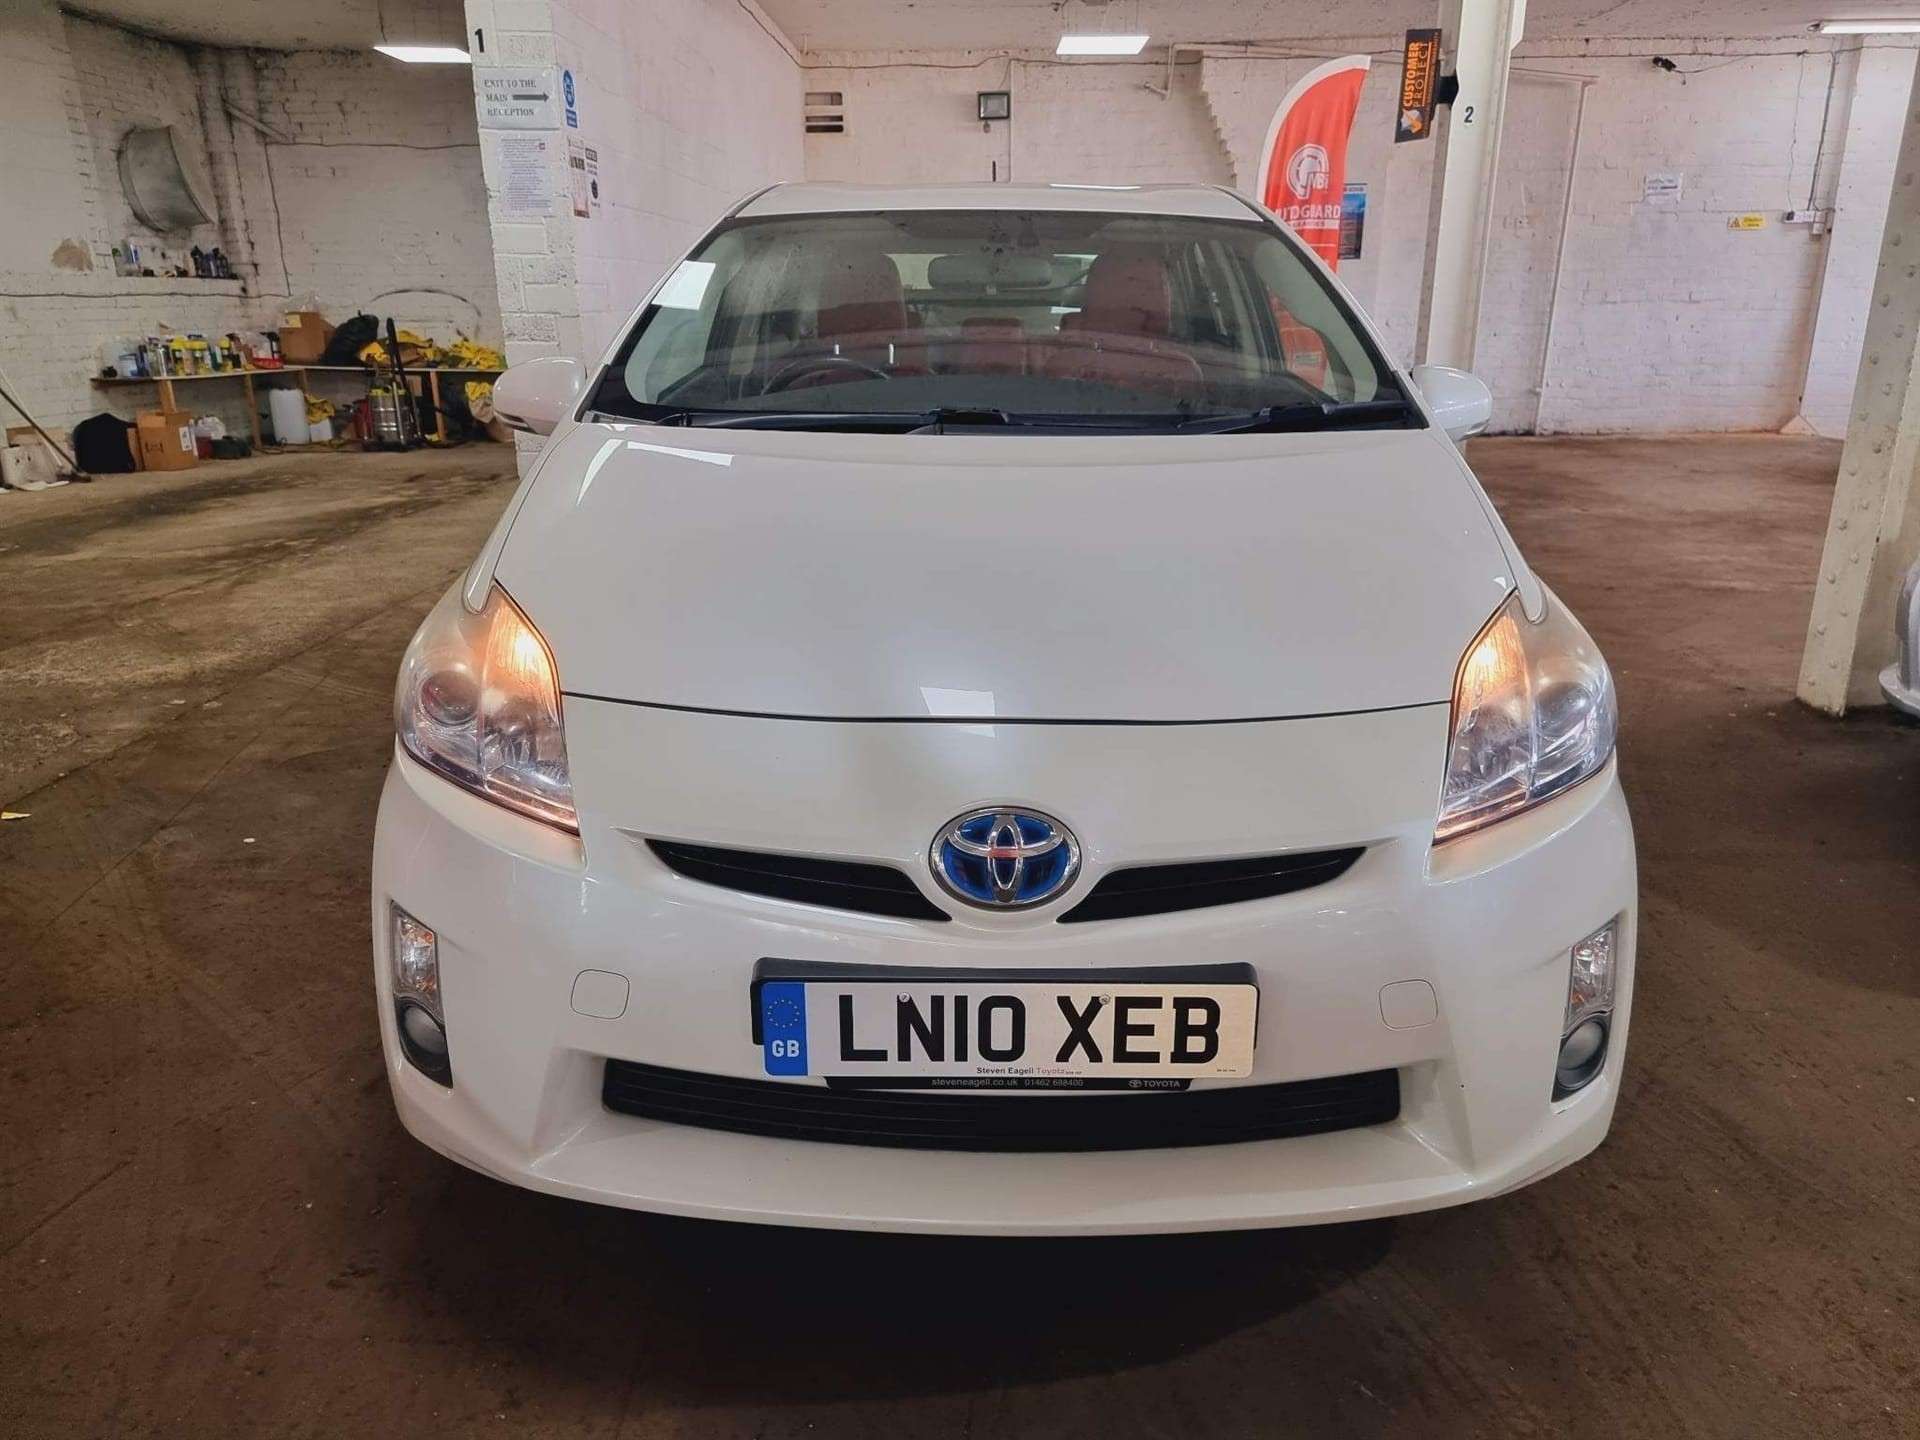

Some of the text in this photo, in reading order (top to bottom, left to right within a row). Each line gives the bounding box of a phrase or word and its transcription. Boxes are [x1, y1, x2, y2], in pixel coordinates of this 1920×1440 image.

[474, 28, 485, 53] 1
[1403, 43, 1420, 107] CUSTOMER
[1413, 43, 1429, 107] PROTECT
[484, 79, 536, 88] EXIT TO THE
[486, 94, 508, 102] MAIN
[488, 108, 534, 116] RECEPTION
[1464, 106, 1474, 123] 2
[839, 994, 1221, 1064] LN10 XEB
[772, 1040, 800, 1057] GB
[976, 1066, 1006, 1075] Steven
[1008, 1066, 1034, 1076] Eagell
[1037, 1066, 1065, 1075] Toyota
[931, 1077, 1018, 1088] steveneagell.co.uk
[1143, 1080, 1181, 1089] TOYOTA
